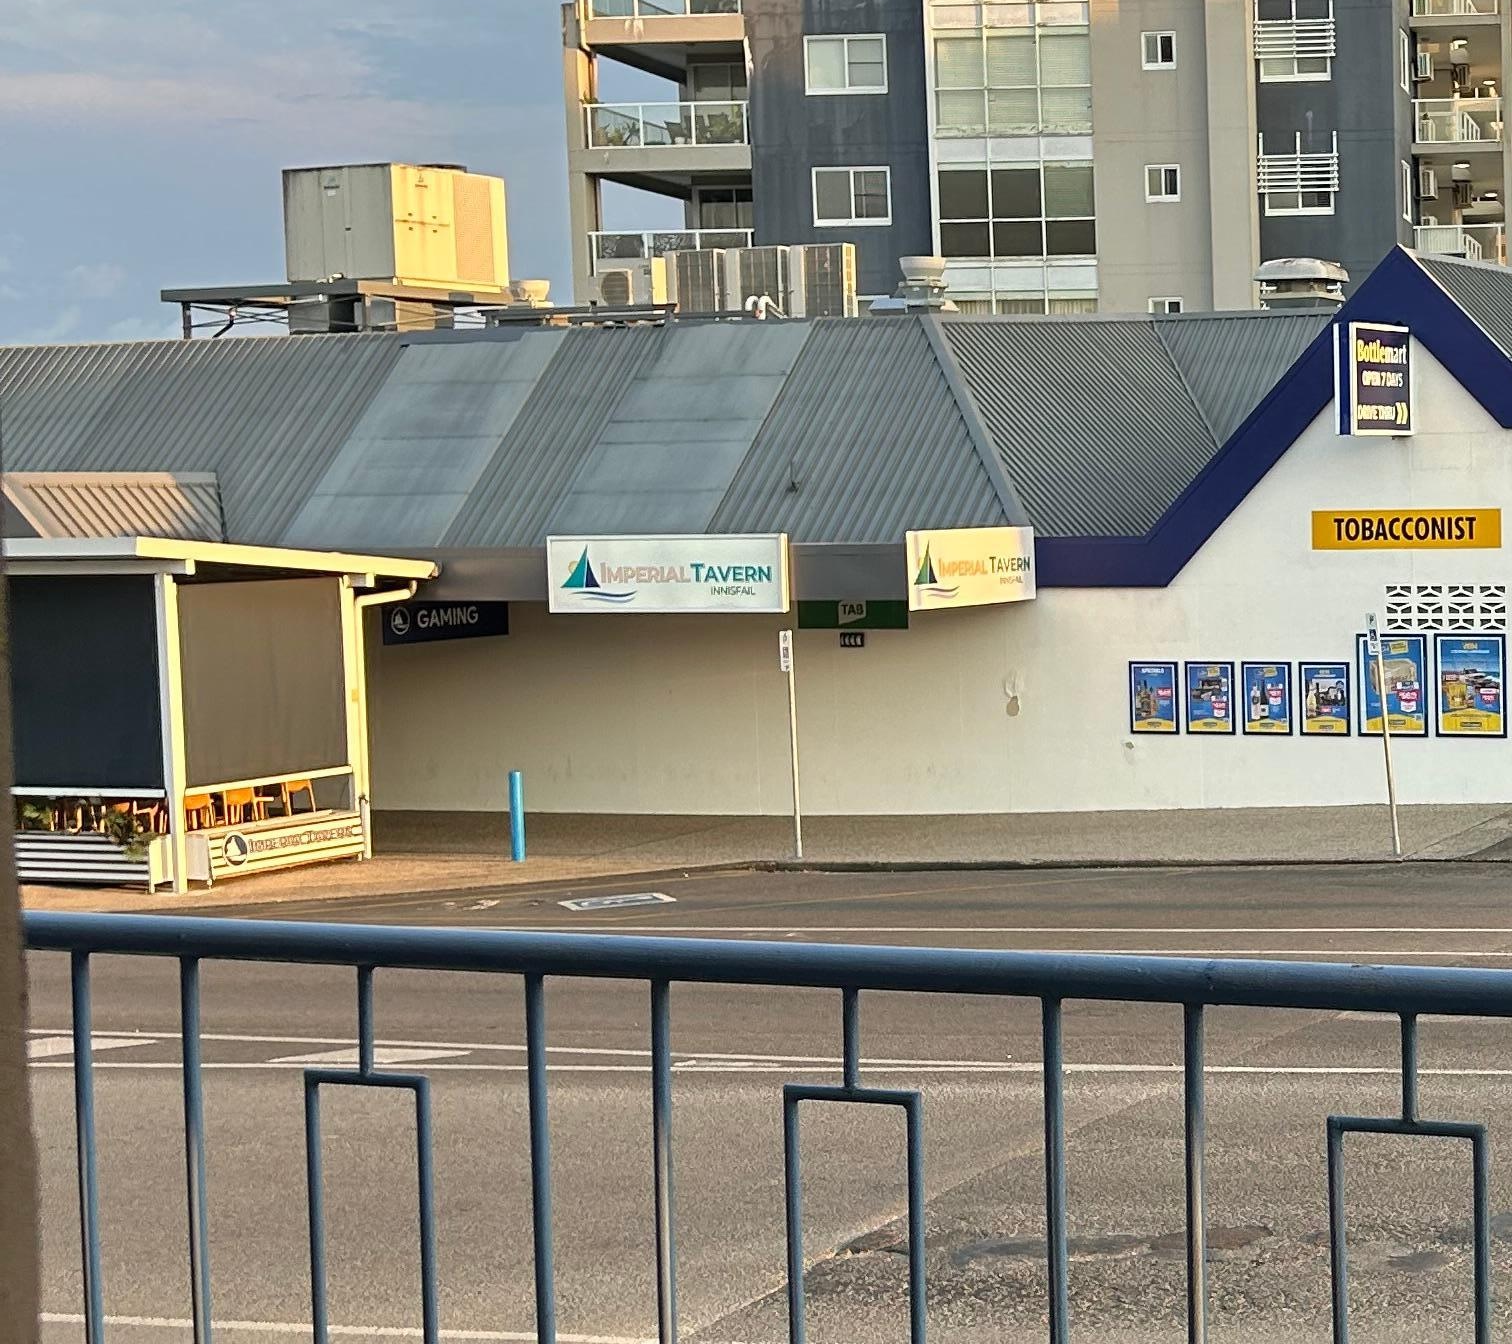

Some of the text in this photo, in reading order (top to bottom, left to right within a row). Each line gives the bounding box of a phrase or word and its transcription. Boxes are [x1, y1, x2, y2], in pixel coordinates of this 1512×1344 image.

[1357, 339, 1407, 364] Bottlemart
[1334, 516, 1476, 541] TOBACCONIST
[600, 562, 772, 584] IMPERIAL TAVERN
[938, 556, 1031, 577] IMPERIAL TAVERN
[711, 586, 755, 596] INNISFAIL
[417, 606, 478, 628] GAMING
[841, 604, 864, 616] TAB
